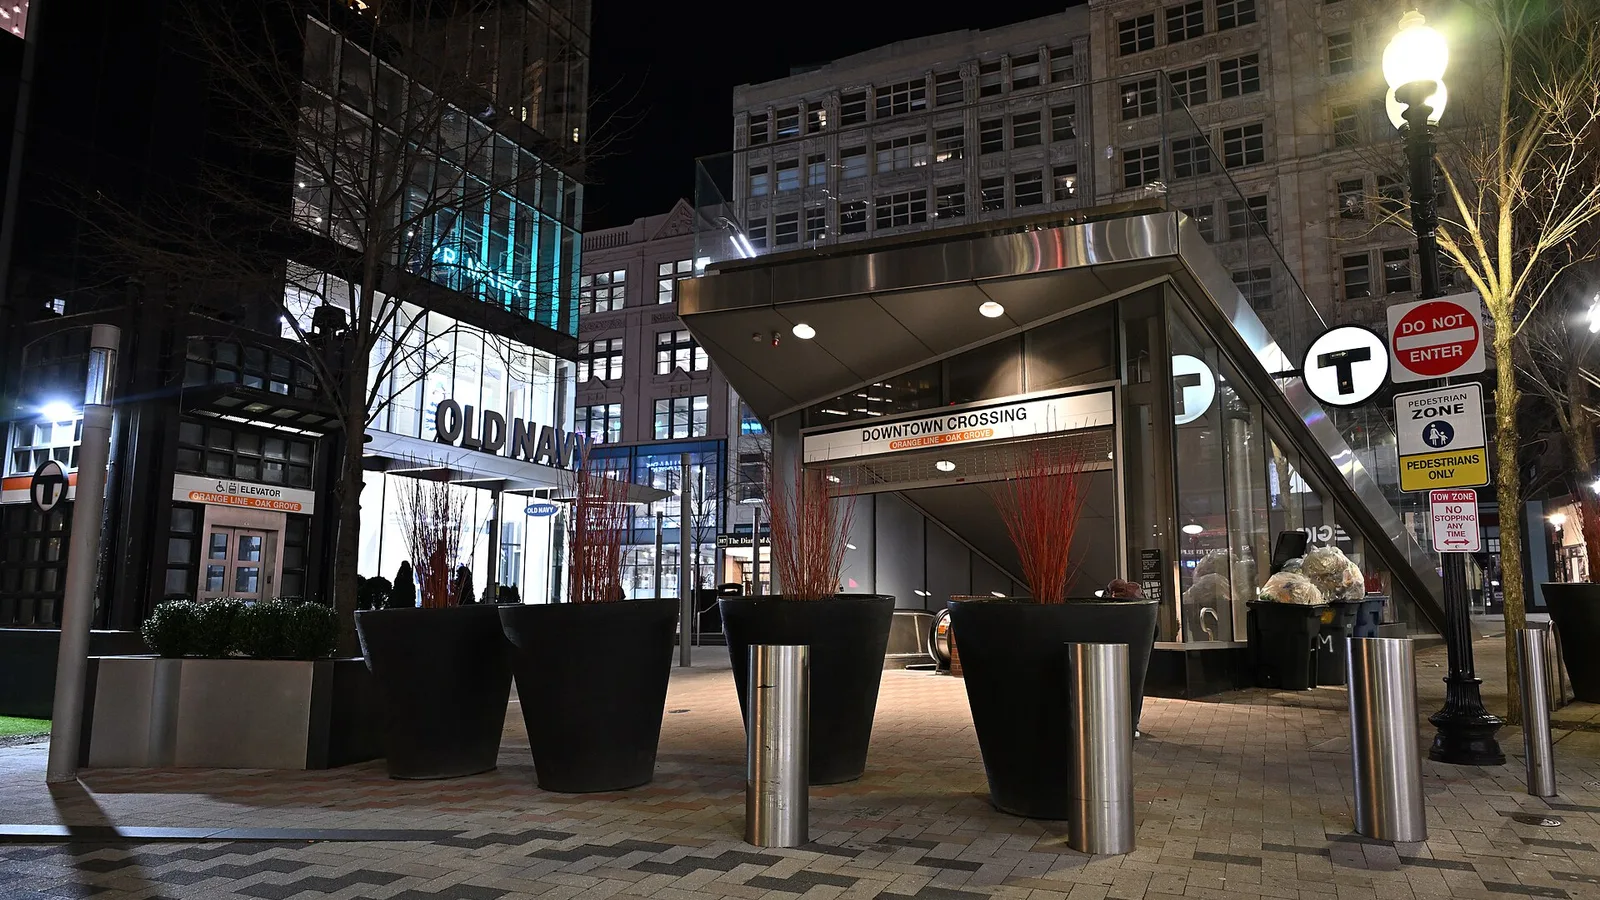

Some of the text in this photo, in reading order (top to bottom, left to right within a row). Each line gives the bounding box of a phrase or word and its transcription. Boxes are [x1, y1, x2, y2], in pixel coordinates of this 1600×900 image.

[1402, 313, 1466, 334] DO NOT
[1410, 345, 1463, 362] ENTER
[1317, 346, 1371, 395] T
[1408, 393, 1467, 408] PEDESTRIAN
[1411, 403, 1465, 420] ZONE
[862, 407, 1027, 442] DOWNTOWN CROSSING
[435, 399, 594, 471] OLD NAVY
[892, 439, 922, 449] ORANGE
[923, 437, 939, 445] LINE
[945, 433, 961, 442] OAK
[963, 429, 991, 440] GROVE
[1407, 454, 1480, 470] PEDESTRIANS
[1428, 469, 1455, 480] ONLY
[240, 485, 281, 497] ELEVATOR
[1432, 492, 1474, 501] TOW ZONE
[192, 493, 228, 503] ORANGE
[230, 497, 248, 505] LINE
[255, 500, 271, 508] OAK
[273, 502, 299, 511] GROVE
[527, 506, 538, 514] OLD
[1445, 505, 1462, 514] NO
[1434, 514, 1475, 522] STOPPING
[729, 537, 739, 545] The
